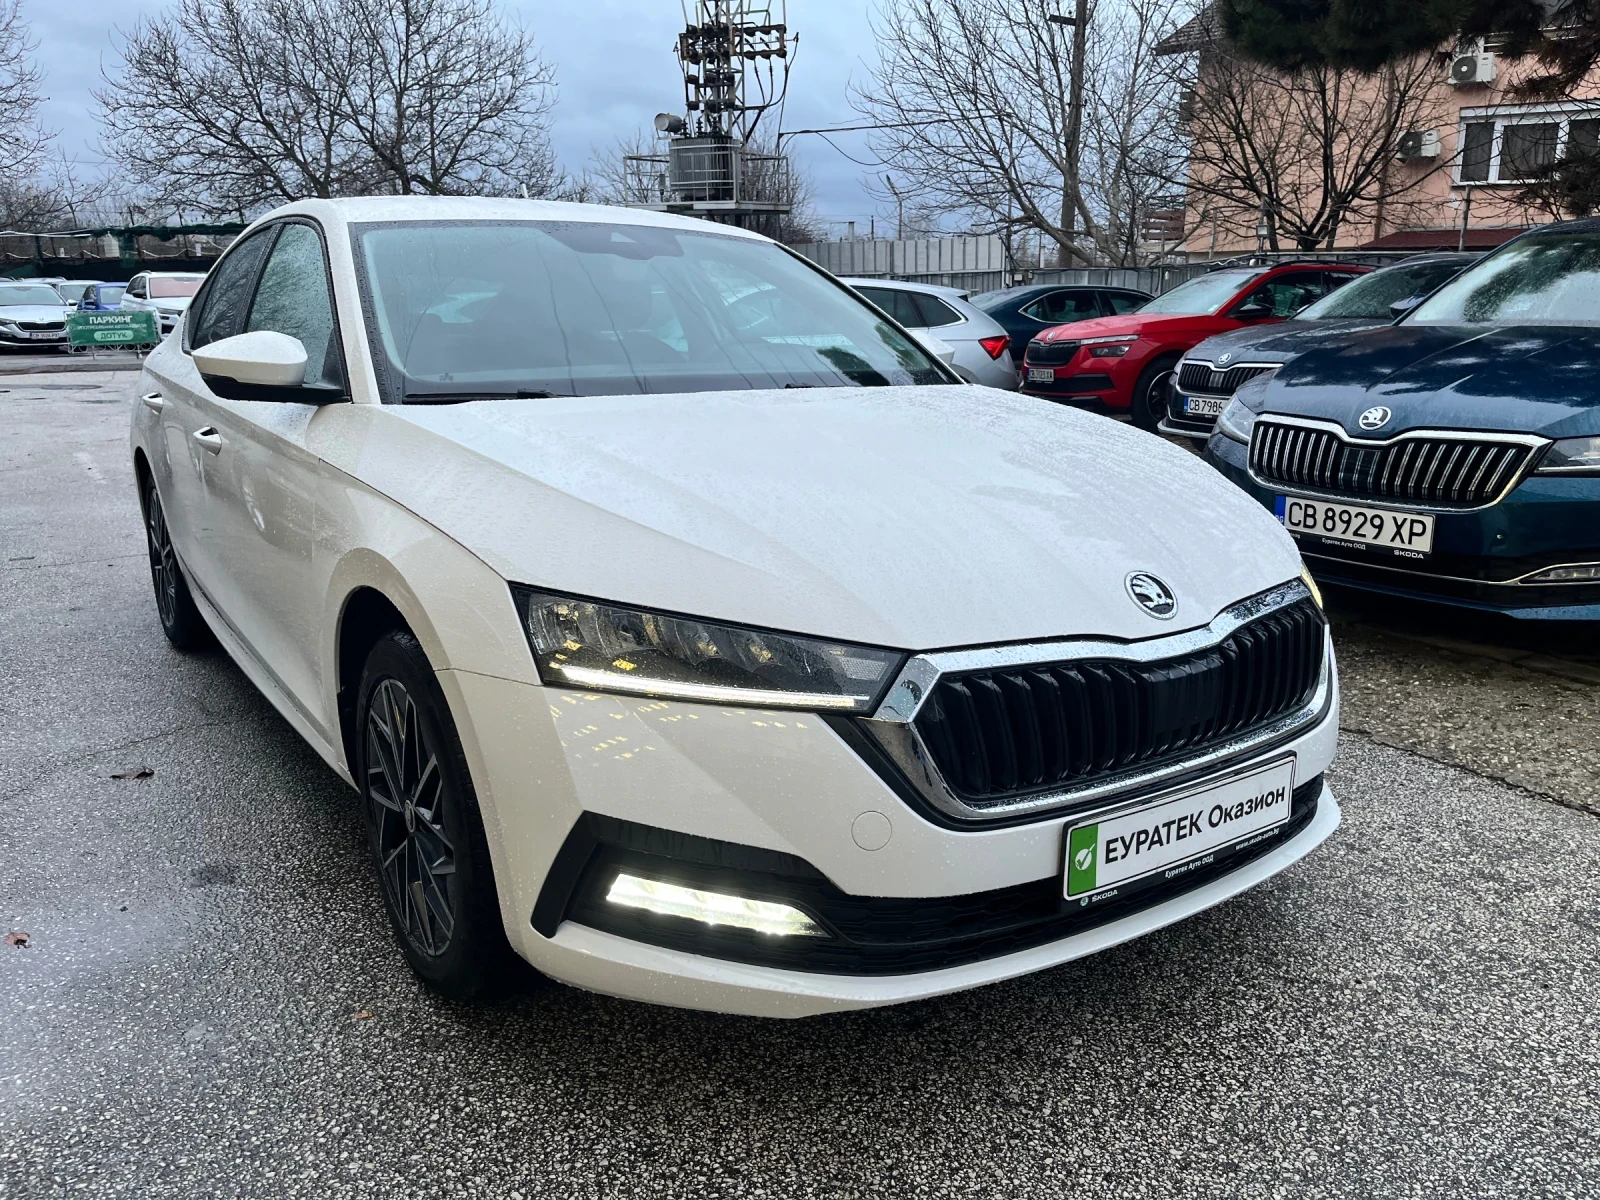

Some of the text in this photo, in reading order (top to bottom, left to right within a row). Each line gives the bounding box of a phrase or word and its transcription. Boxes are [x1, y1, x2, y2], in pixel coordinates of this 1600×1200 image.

[89, 315, 133, 325] ПАРКИНГ
[100, 331, 128, 340] ДОТУК
[1189, 399, 1200, 411] CB
[1288, 501, 1427, 545] CB 8929 XP
[1104, 786, 1286, 865] ЕУРАТЕК Оказион
